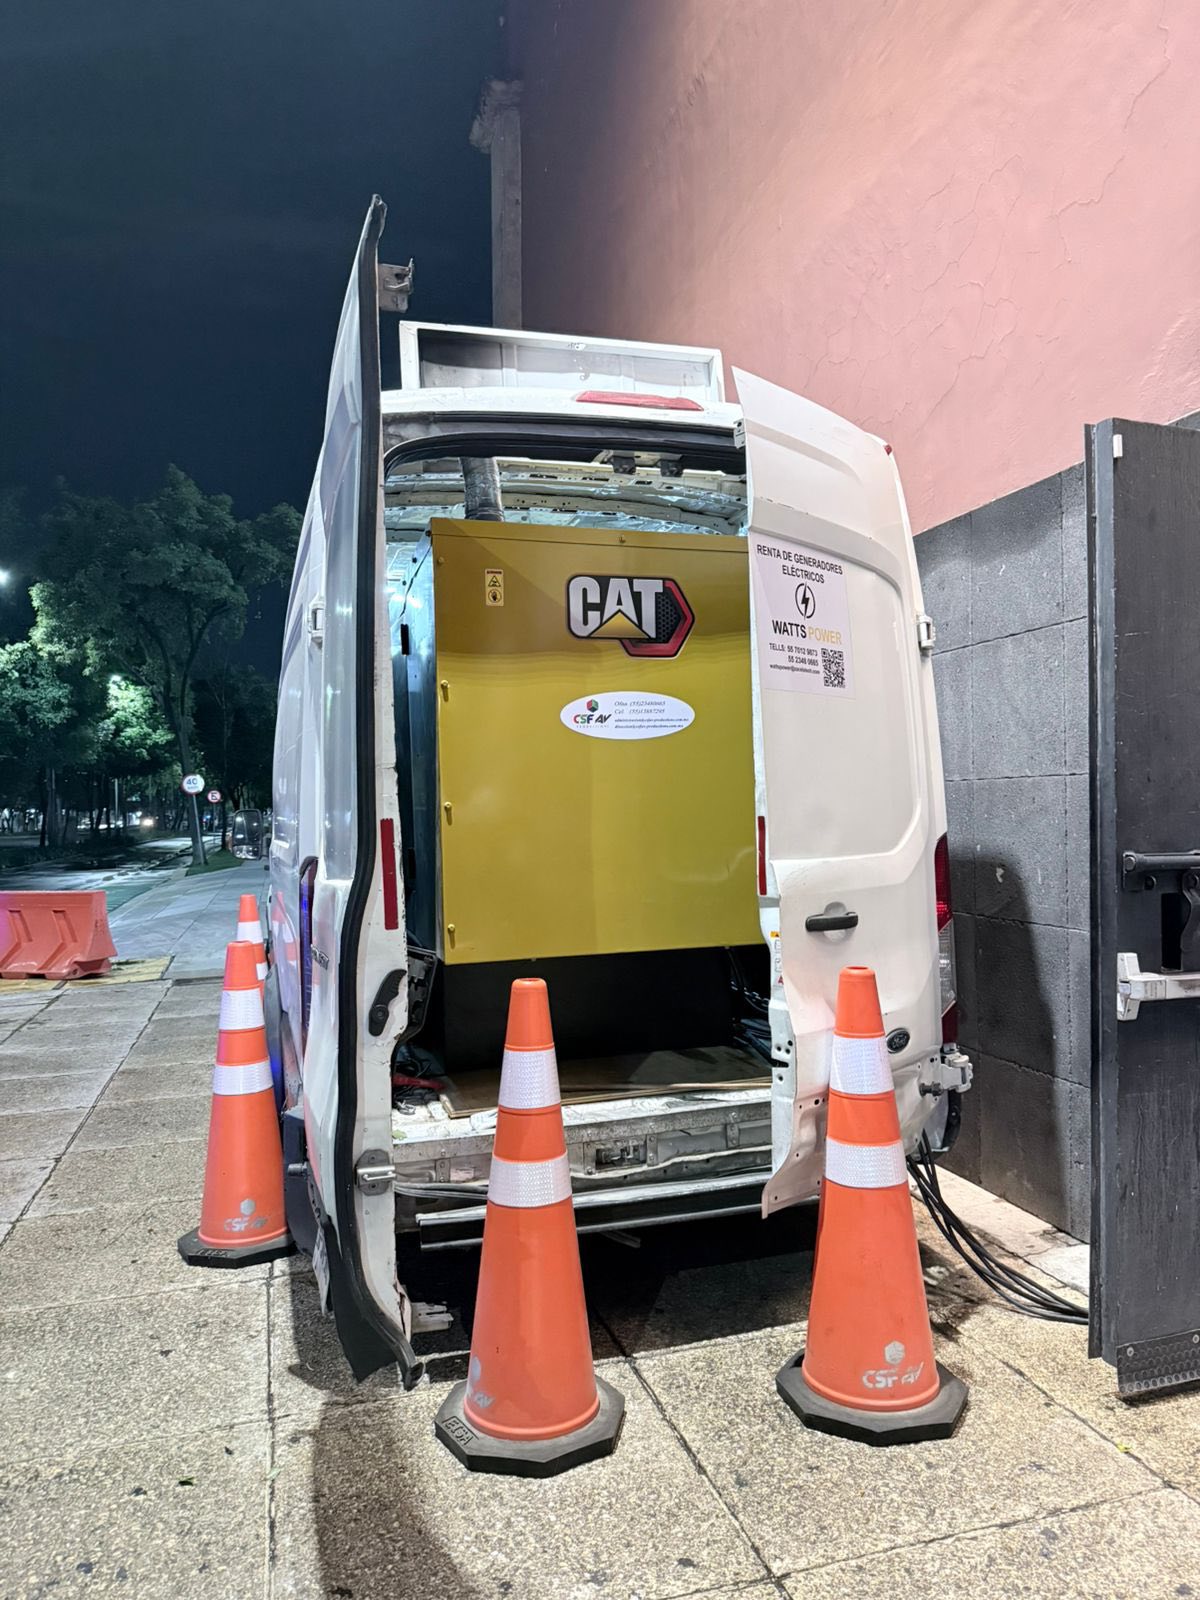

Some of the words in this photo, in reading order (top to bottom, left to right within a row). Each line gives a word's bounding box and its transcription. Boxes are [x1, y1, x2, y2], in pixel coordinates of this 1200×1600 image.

[757, 544, 782, 560] RENTA
[783, 550, 793, 562] DE
[794, 553, 843, 575] GENERADORES
[782, 564, 825, 584] ELÉCTRICOS
[568, 576, 664, 638] CAT
[772, 620, 807, 639] WATTS
[808, 626, 842, 645] POWER
[573, 713, 594, 724] CSF
[595, 713, 612, 724] AV
[186, 777, 198, 785] 40
[862, 1367, 899, 1388] CSF
